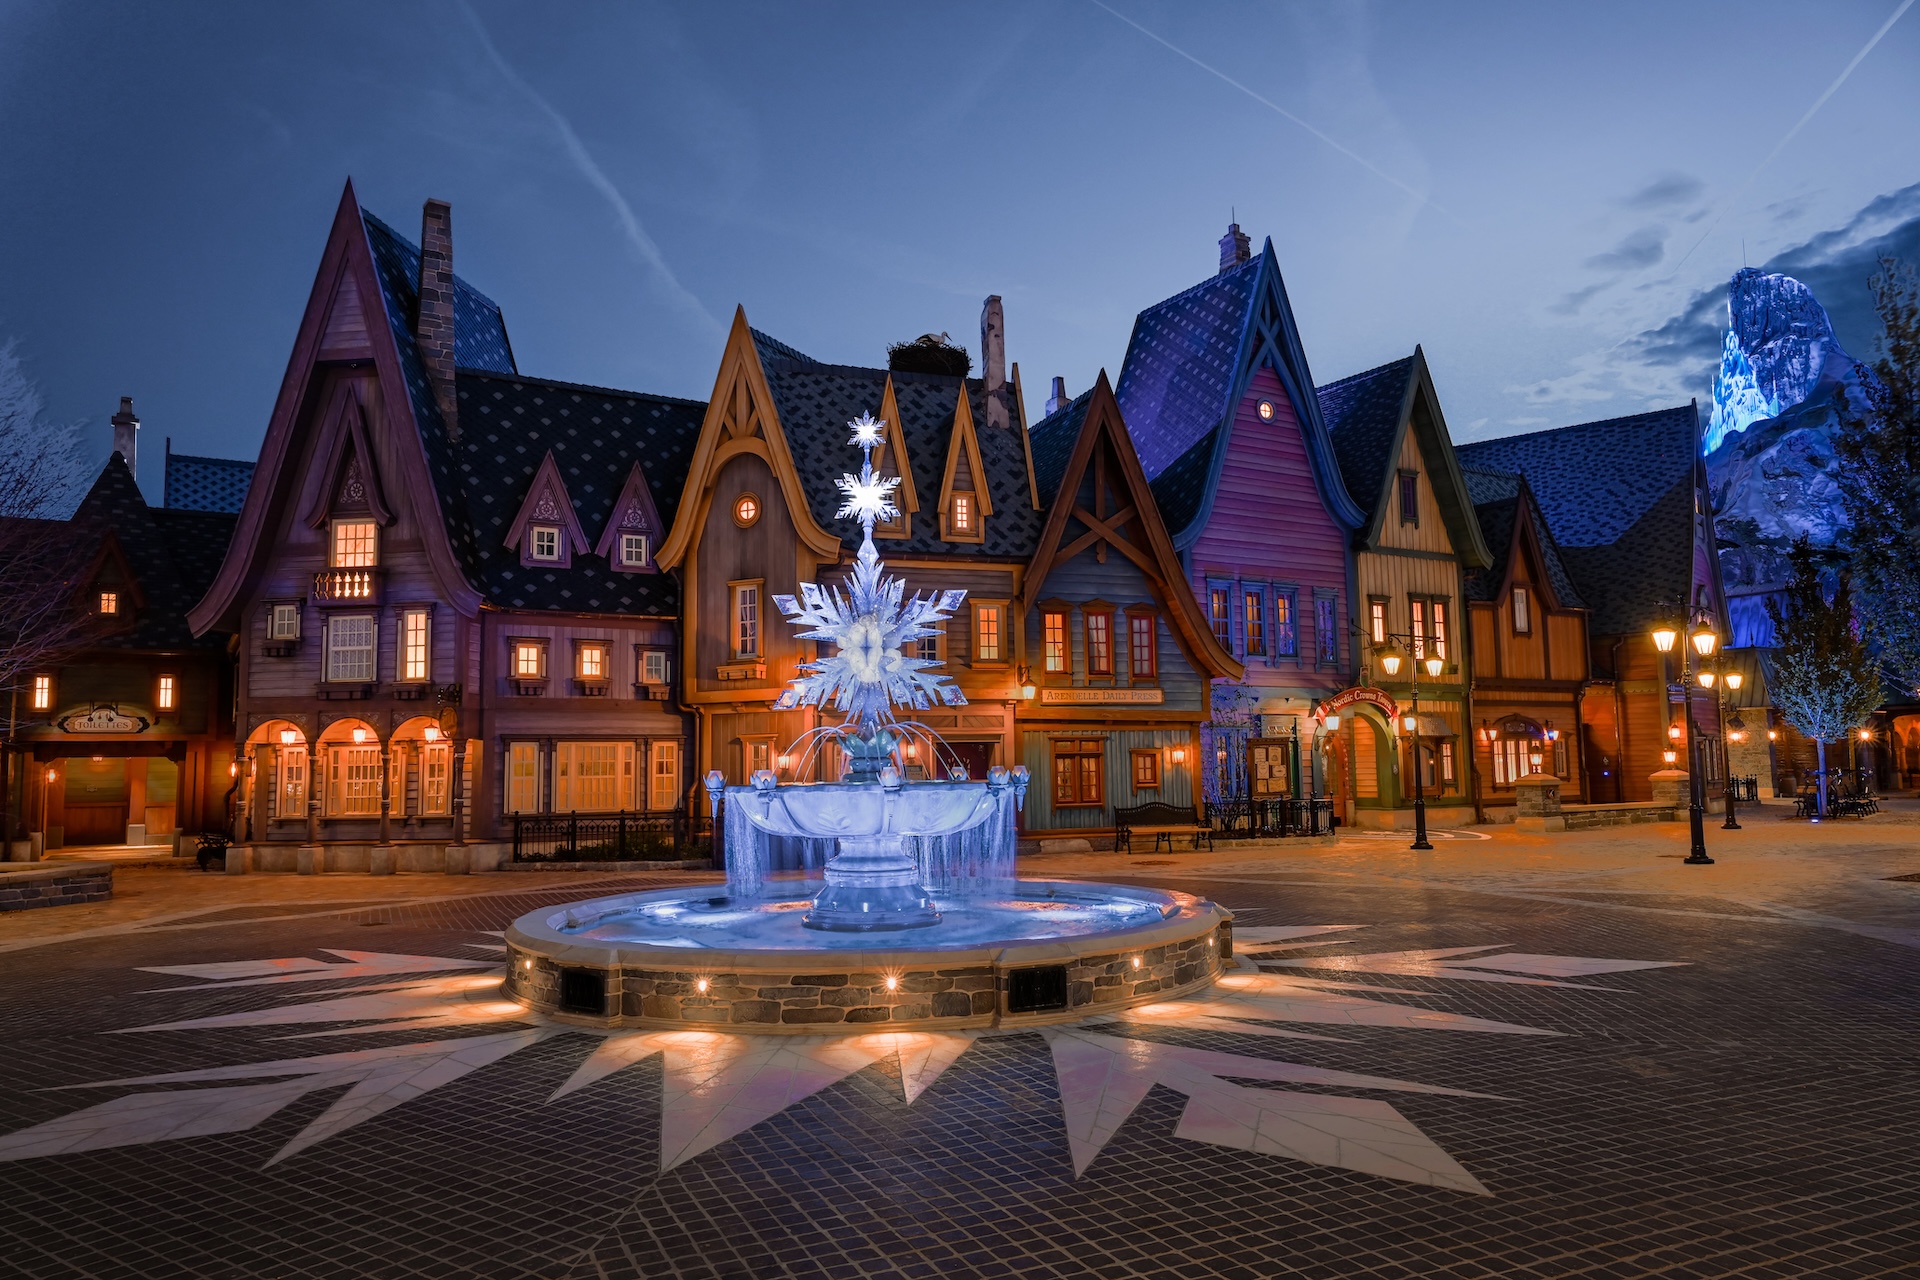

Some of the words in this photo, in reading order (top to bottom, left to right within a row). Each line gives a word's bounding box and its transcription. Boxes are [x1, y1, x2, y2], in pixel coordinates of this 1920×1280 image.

[1046, 691, 1099, 700] ARENDELLE
[1102, 691, 1127, 700] DAILY
[1131, 691, 1158, 700] PRESS
[1332, 693, 1353, 709] Nordic
[1354, 690, 1376, 700] Crowns
